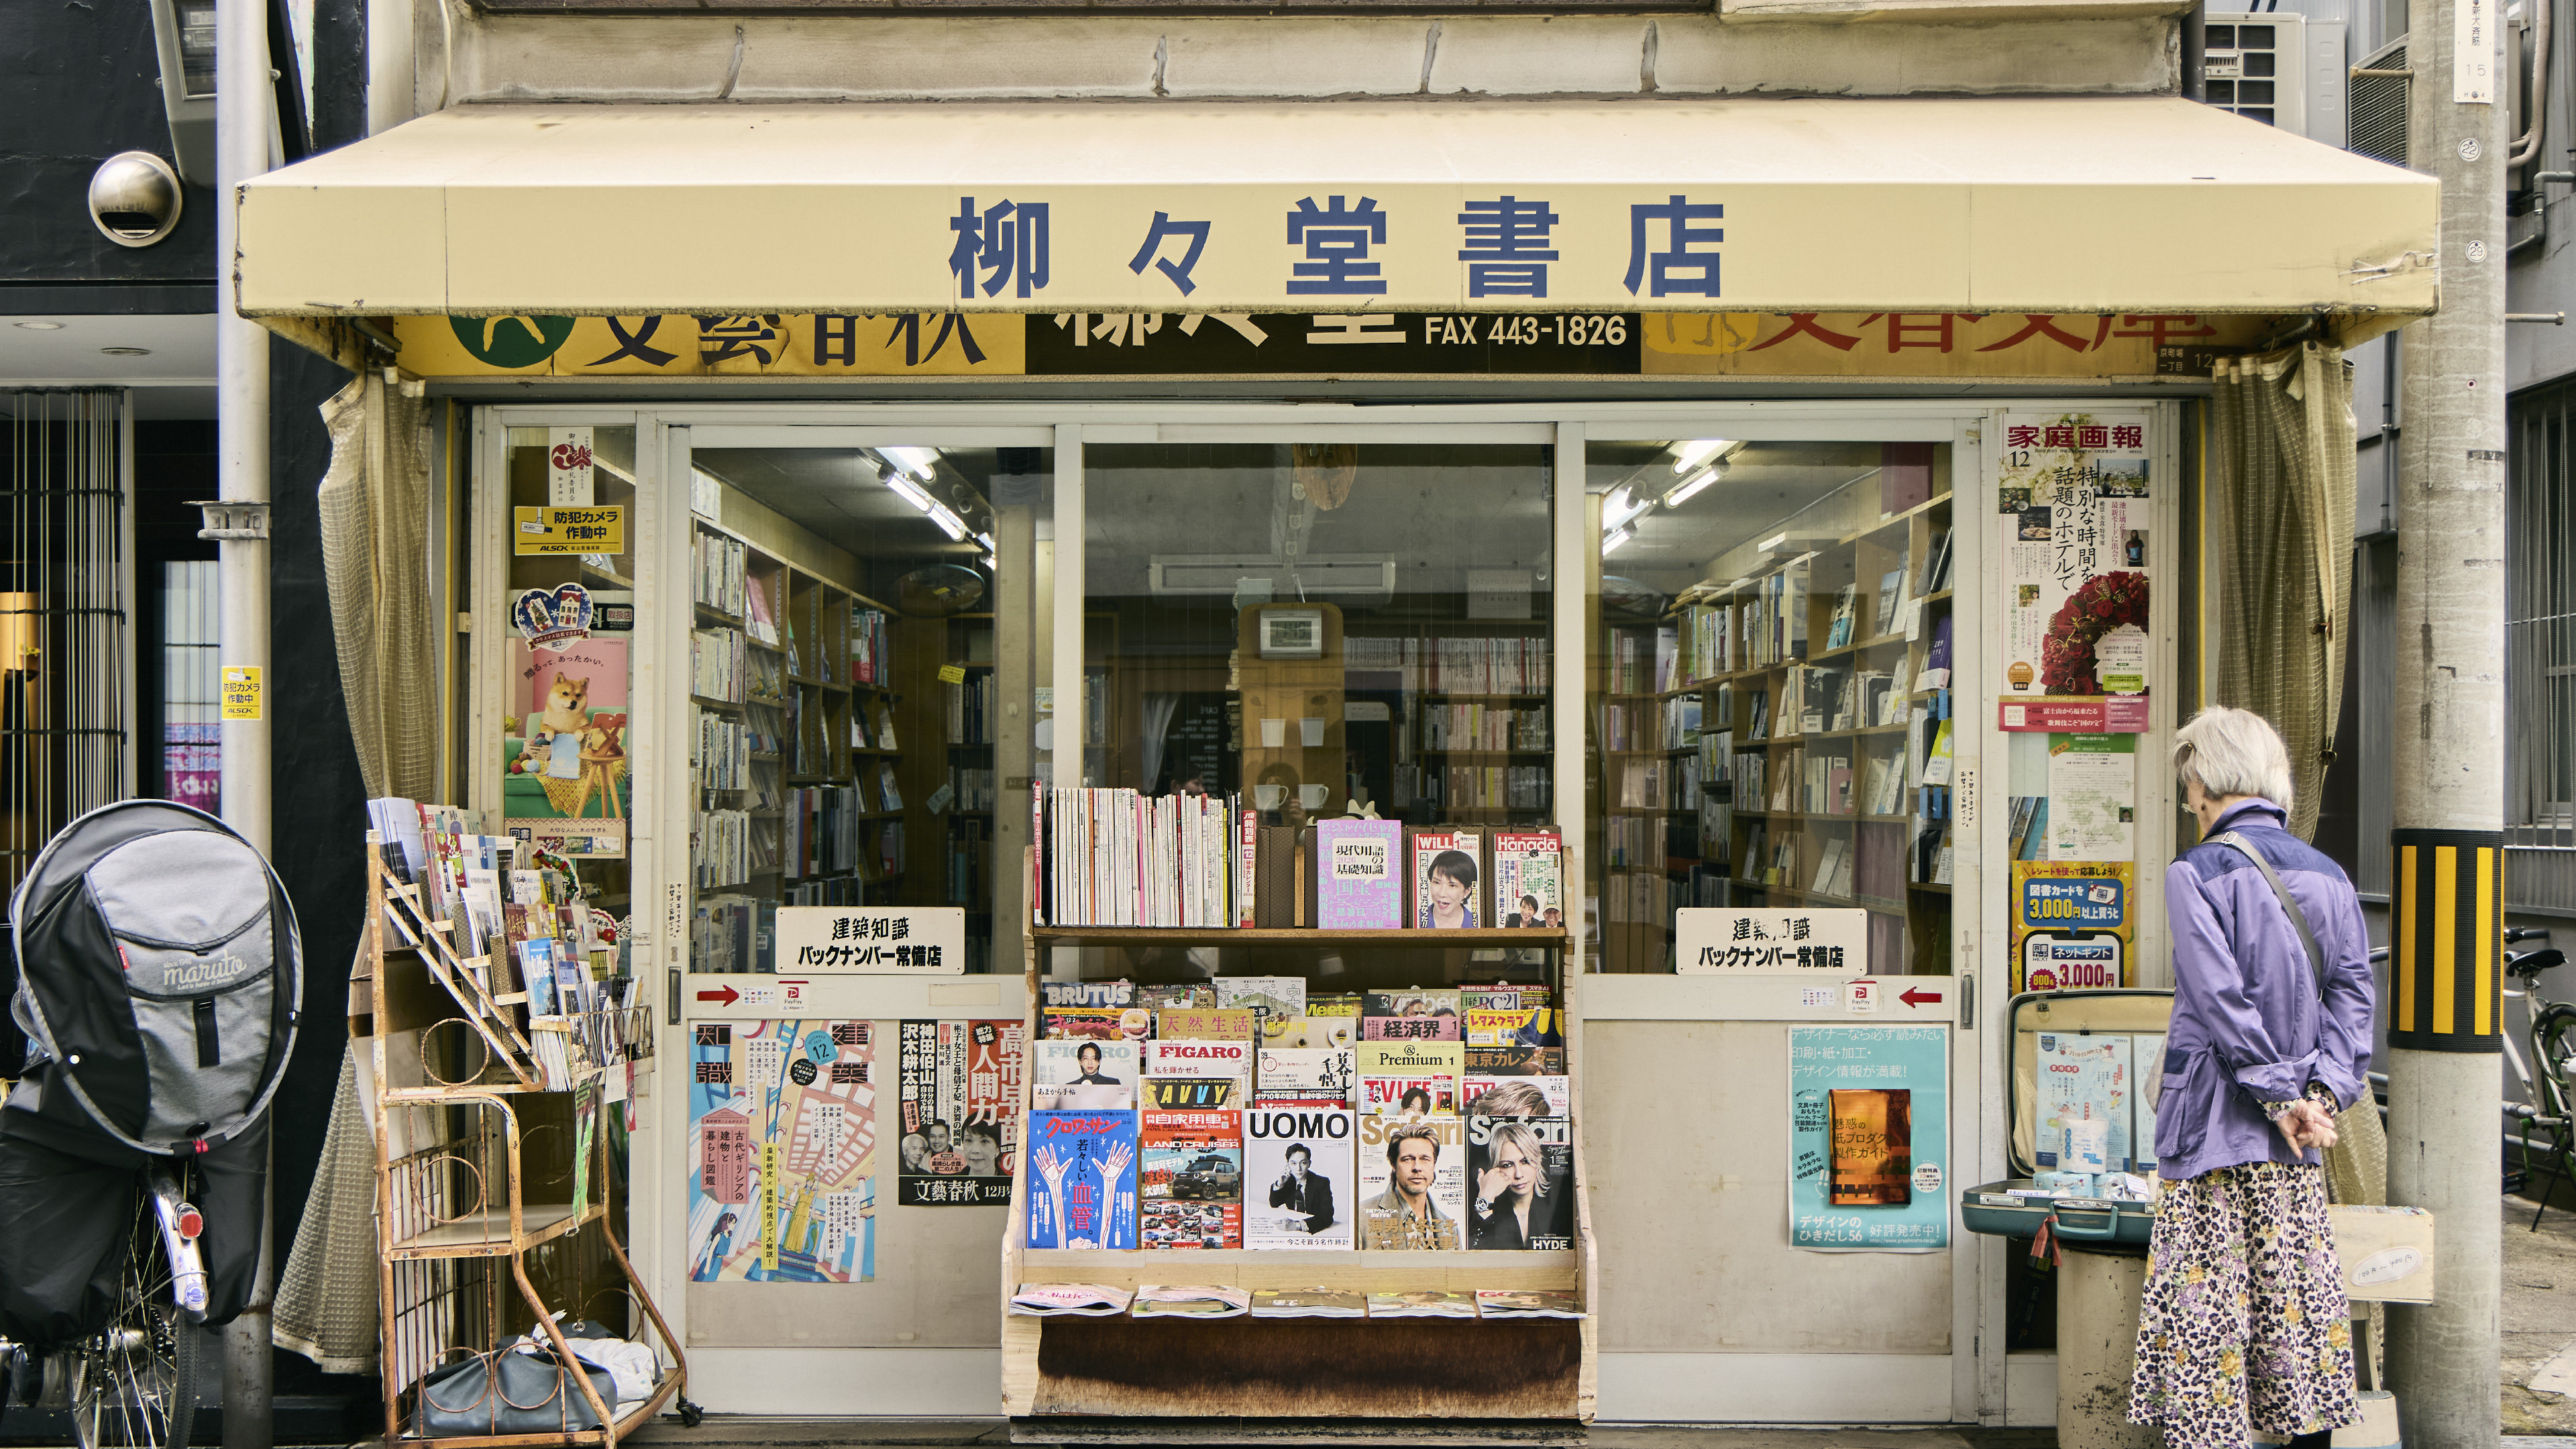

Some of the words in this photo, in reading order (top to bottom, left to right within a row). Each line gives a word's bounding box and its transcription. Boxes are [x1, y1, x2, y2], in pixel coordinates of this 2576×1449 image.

[2462, 144, 2476, 155] 22
[949, 195, 1725, 299] 柳々堂書店
[2469, 246, 2483, 257] 29
[1426, 317, 1477, 345] FAX
[1487, 316, 1627, 346] 443-1826
[2159, 362, 2183, 371] 一丁目
[2194, 353, 2213, 368] 12
[2008, 425, 2143, 449] 家庭画報
[2010, 451, 2031, 468] 12
[554, 511, 618, 524] 防犯カメラ
[2076, 466, 2098, 584] 特別な時間を
[566, 526, 607, 539] 作動中
[2052, 466, 2076, 591] 話題のホテルで
[608, 610, 632, 621] 取扱店
[223, 683, 260, 692] 防犯カメラ
[228, 694, 254, 704] 作動中
[1244, 820, 1254, 843] 時刻表
[1336, 845, 1384, 856] 現代用語
[1419, 837, 1453, 849] WiLL
[1454, 839, 1460, 850] 1
[1498, 837, 1558, 851] Hanada
[1244, 850, 1254, 859] 12
[1372, 856, 1384, 864] の
[1336, 864, 1384, 875] 基礎知識
[2029, 884, 2084, 896] 図書カードを
[2029, 898, 2118, 920] 3,000円以上買うと
[832, 916, 910, 941] 建築知識
[798, 945, 943, 967] バックナンバー常備店
[1698, 945, 1844, 968] バックナンバー常備店
[2054, 947, 2110, 958] ネットギフト
[164, 949, 248, 985] maruto
[2059, 964, 2114, 989] 3,000円
[1044, 983, 1133, 1005] BRUTUS
[1381, 996, 1389, 1006] 12
[1479, 993, 1518, 1010] PC21
[1164, 1016, 1249, 1033] 天然生活
[1383, 1020, 1441, 1038] 経済界
[1452, 1021, 1457, 1030] 1
[1470, 1014, 1526, 1027] レタスクラブ
[1792, 1028, 1945, 1041] デザイナーなら必ず読みたい
[812, 1043, 830, 1060] 12
[919, 1023, 936, 1085] 神田伯山
[1159, 1046, 1242, 1059] FIGARO
[1260, 1052, 1268, 1060] 39
[1379, 1053, 1443, 1065] Premium
[1448, 1057, 1454, 1066] 1
[902, 1023, 919, 1102] 沢木耕太郎
[953, 1024, 962, 1102] 彬子女王と母信子妃
[1154, 1066, 1200, 1074] 私を輝かせる
[970, 1044, 1000, 1126] 人間力
[998, 1023, 1025, 1146] 高市早苗
[1038, 1087, 1077, 1096] あまから手帖
[1144, 1085, 1228, 1104] SAVVY
[953, 1104, 962, 1146] 決裂の瞬間
[1046, 1116, 1122, 1139] クロワッサン
[1155, 1114, 1222, 1124] 自家用車
[1250, 1112, 1349, 1139] UOMO
[1835, 1117, 1866, 1130] 魅惑の
[719, 1130, 731, 1163] 建物と
[1835, 1146, 1889, 1159] 製作ガイド
[704, 1130, 716, 1186] 暮らし図鑑
[734, 1130, 746, 1201] 古代ギリシアの
[1076, 1138, 1089, 1181] 若々しい
[914, 1179, 980, 1201] 文藝春秋
[1145, 1184, 1169, 1197] 大研究
[1071, 1181, 1093, 1235] 血管。
[1799, 1216, 1862, 1228] デザインの
[1799, 1229, 1863, 1242] ひきだし56
[1869, 1224, 1940, 1238] 好評発売中!
[1533, 1240, 1568, 1250] HYDE
